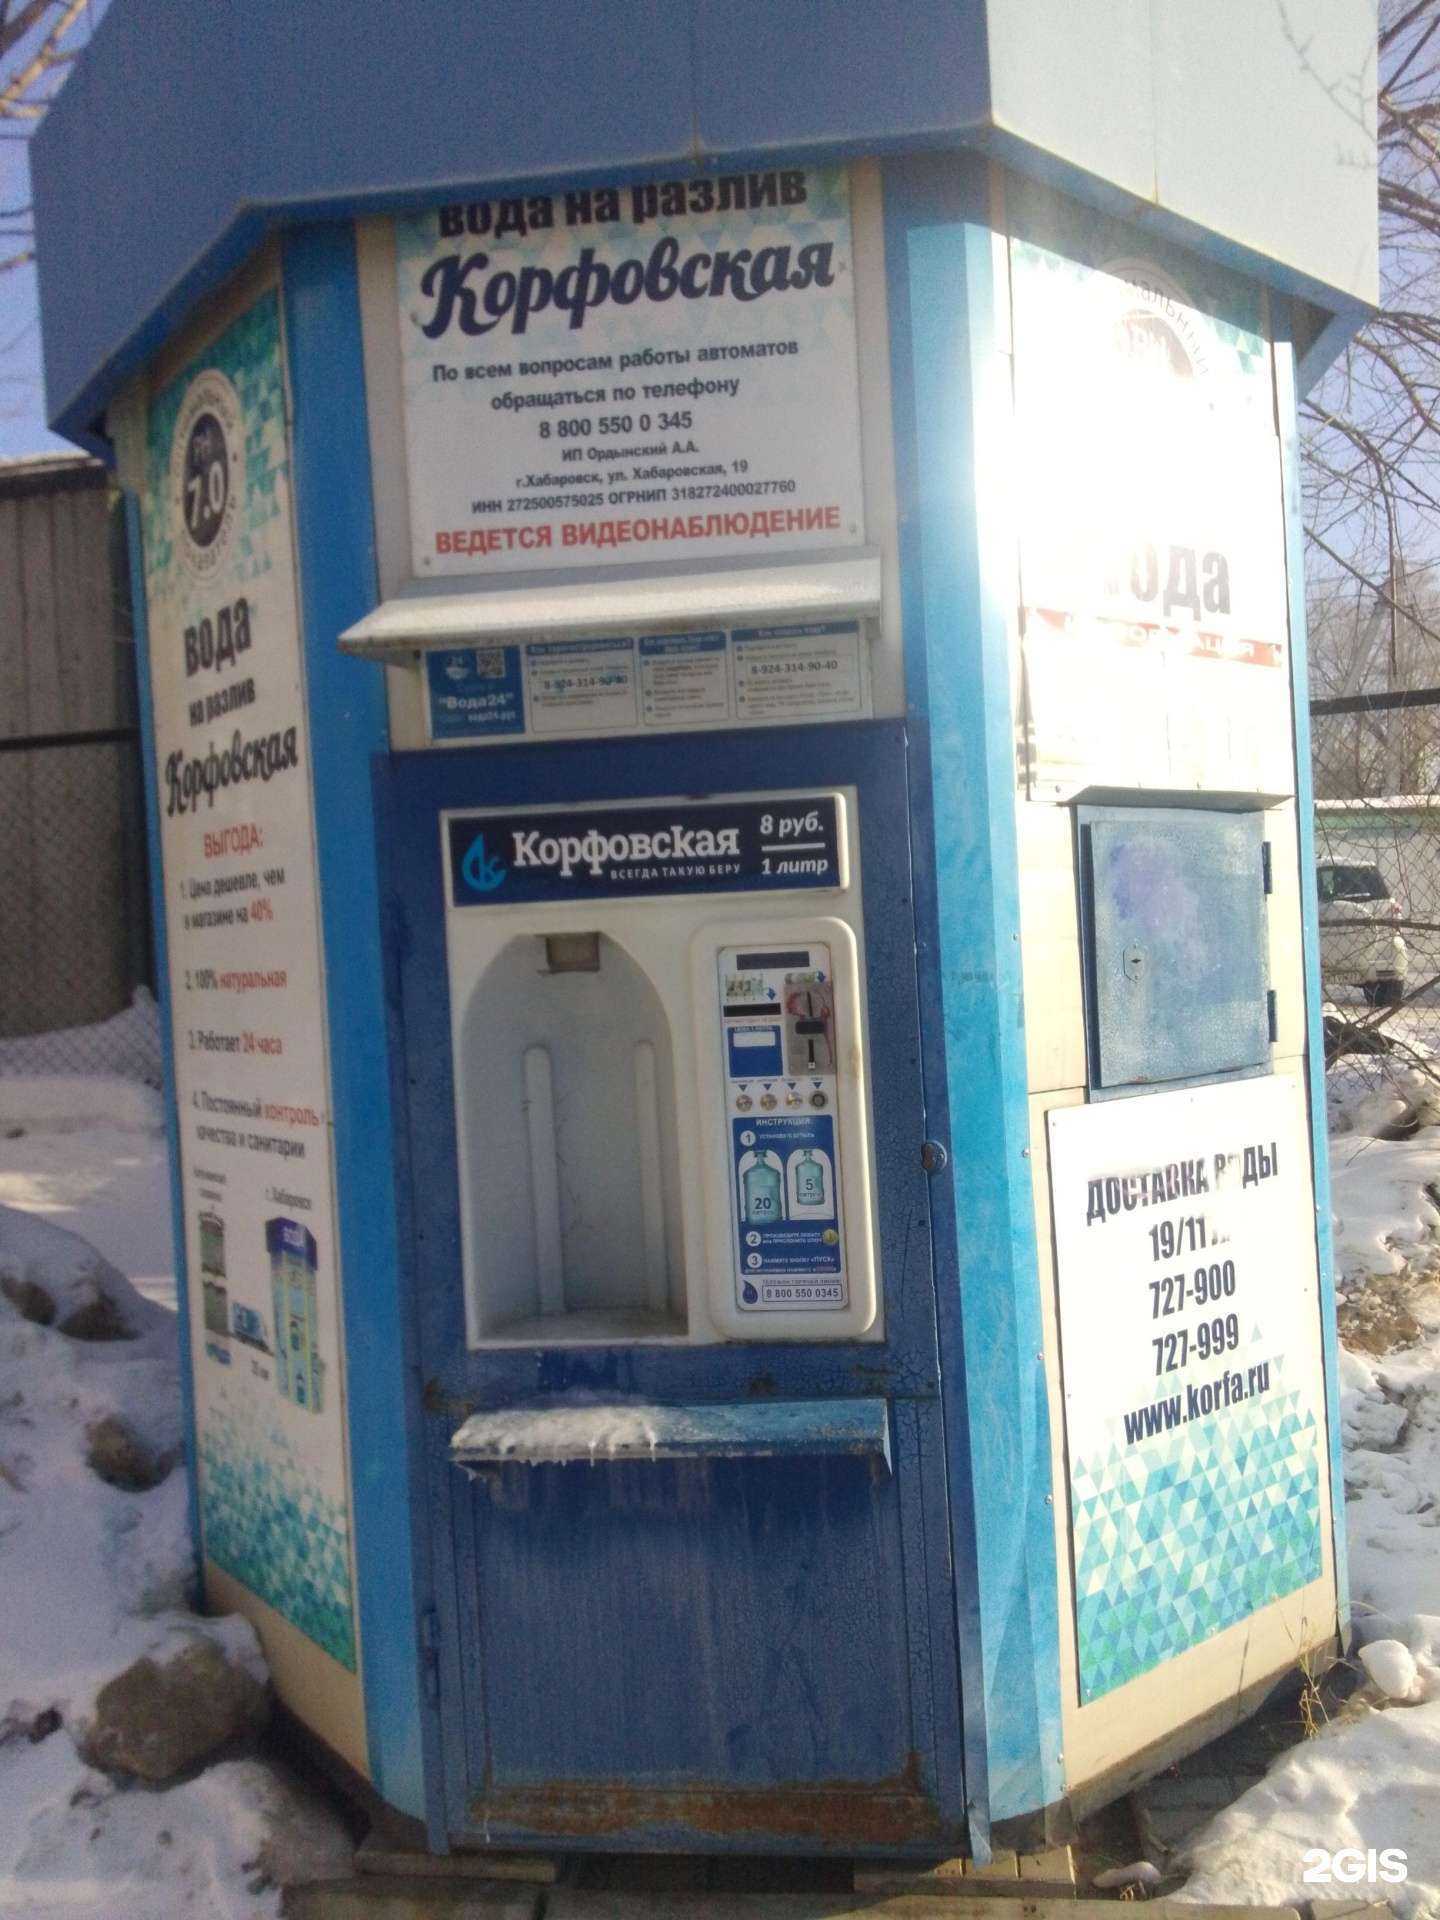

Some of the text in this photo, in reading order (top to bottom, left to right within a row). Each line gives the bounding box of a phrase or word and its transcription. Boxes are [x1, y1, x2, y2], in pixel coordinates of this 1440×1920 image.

[439, 171, 808, 239] вода на разлив
[420, 236, 835, 339] Корфовская
[432, 341, 799, 382] По всем вопросам работы автоматов
[491, 378, 741, 412] обращаться по телефону
[539, 411, 693, 439] 8 800 550 0 345
[562, 440, 699, 462] ИП Ордынский А.А.
[607, 470, 628, 485] ул.
[632, 462, 727, 482] Хабаровская,
[731, 459, 749, 474] 19
[472, 500, 502, 514] ИНН
[608, 488, 666, 505] ОГРНИП
[435, 506, 840, 556] ВЕДЕТСЯ ВИДЕОНАБЛЮДЕНИЕ
[1129, 542, 1232, 622] ода
[184, 597, 252, 677] вода
[206, 677, 256, 724] разлив
[165, 725, 299, 818] Корфовская
[204, 824, 264, 859] ВЫГОДА:
[760, 811, 824, 840] 8 руб.
[512, 825, 741, 878] Корфовская
[761, 858, 829, 877] 1 литр
[263, 867, 285, 886] чем
[610, 863, 741, 880] ВСЕГДА ТАКУЮ БЕРУ
[805, 1178, 814, 1191] 5
[1086, 1156, 1210, 1227] ДОСТАВКА
[754, 1197, 772, 1210] 20
[750, 1234, 758, 1245] 2
[751, 1255, 759, 1266] 3
[1149, 1259, 1236, 1319] 727-900
[1152, 1313, 1240, 1377] 727-999
[1124, 1361, 1271, 1446] www.korfa.ru
